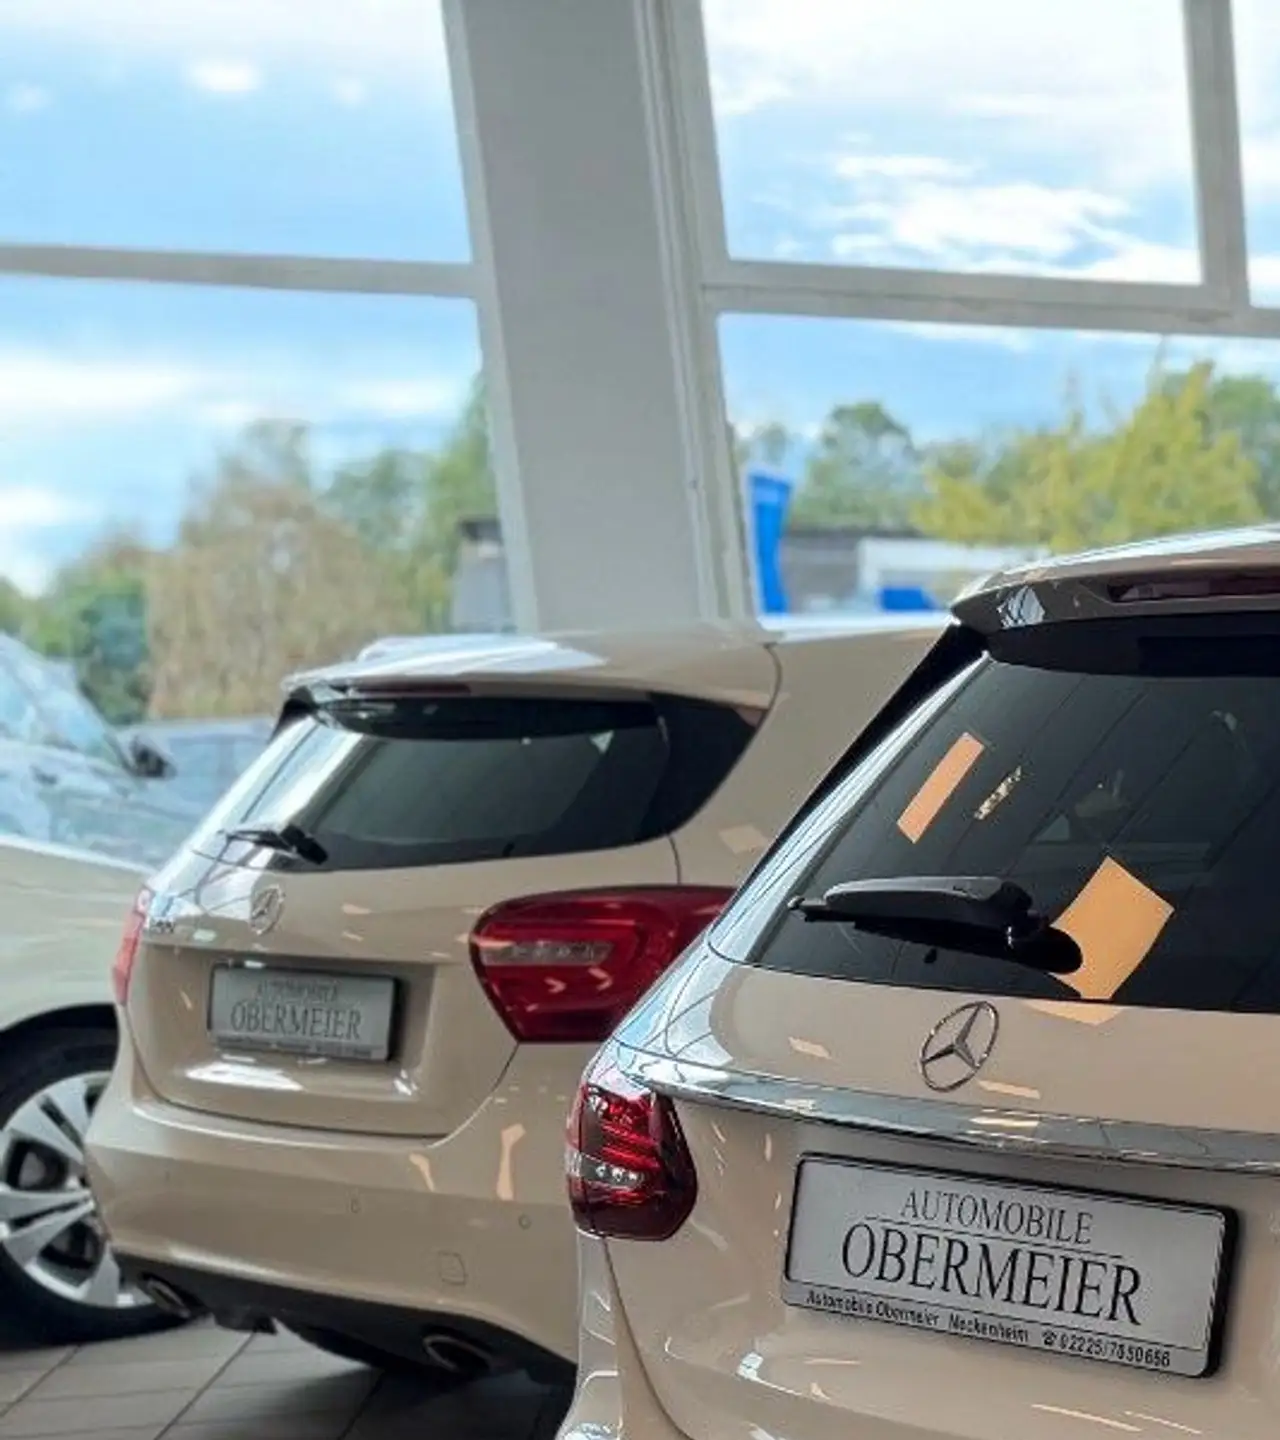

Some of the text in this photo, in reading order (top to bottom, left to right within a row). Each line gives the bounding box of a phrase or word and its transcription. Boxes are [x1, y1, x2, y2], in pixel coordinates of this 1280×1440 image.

[230, 1000, 362, 1040] OBERMEIER
[901, 1187, 1094, 1245] AUTOMOBILE
[842, 1223, 1142, 1326] OBERMEIER
